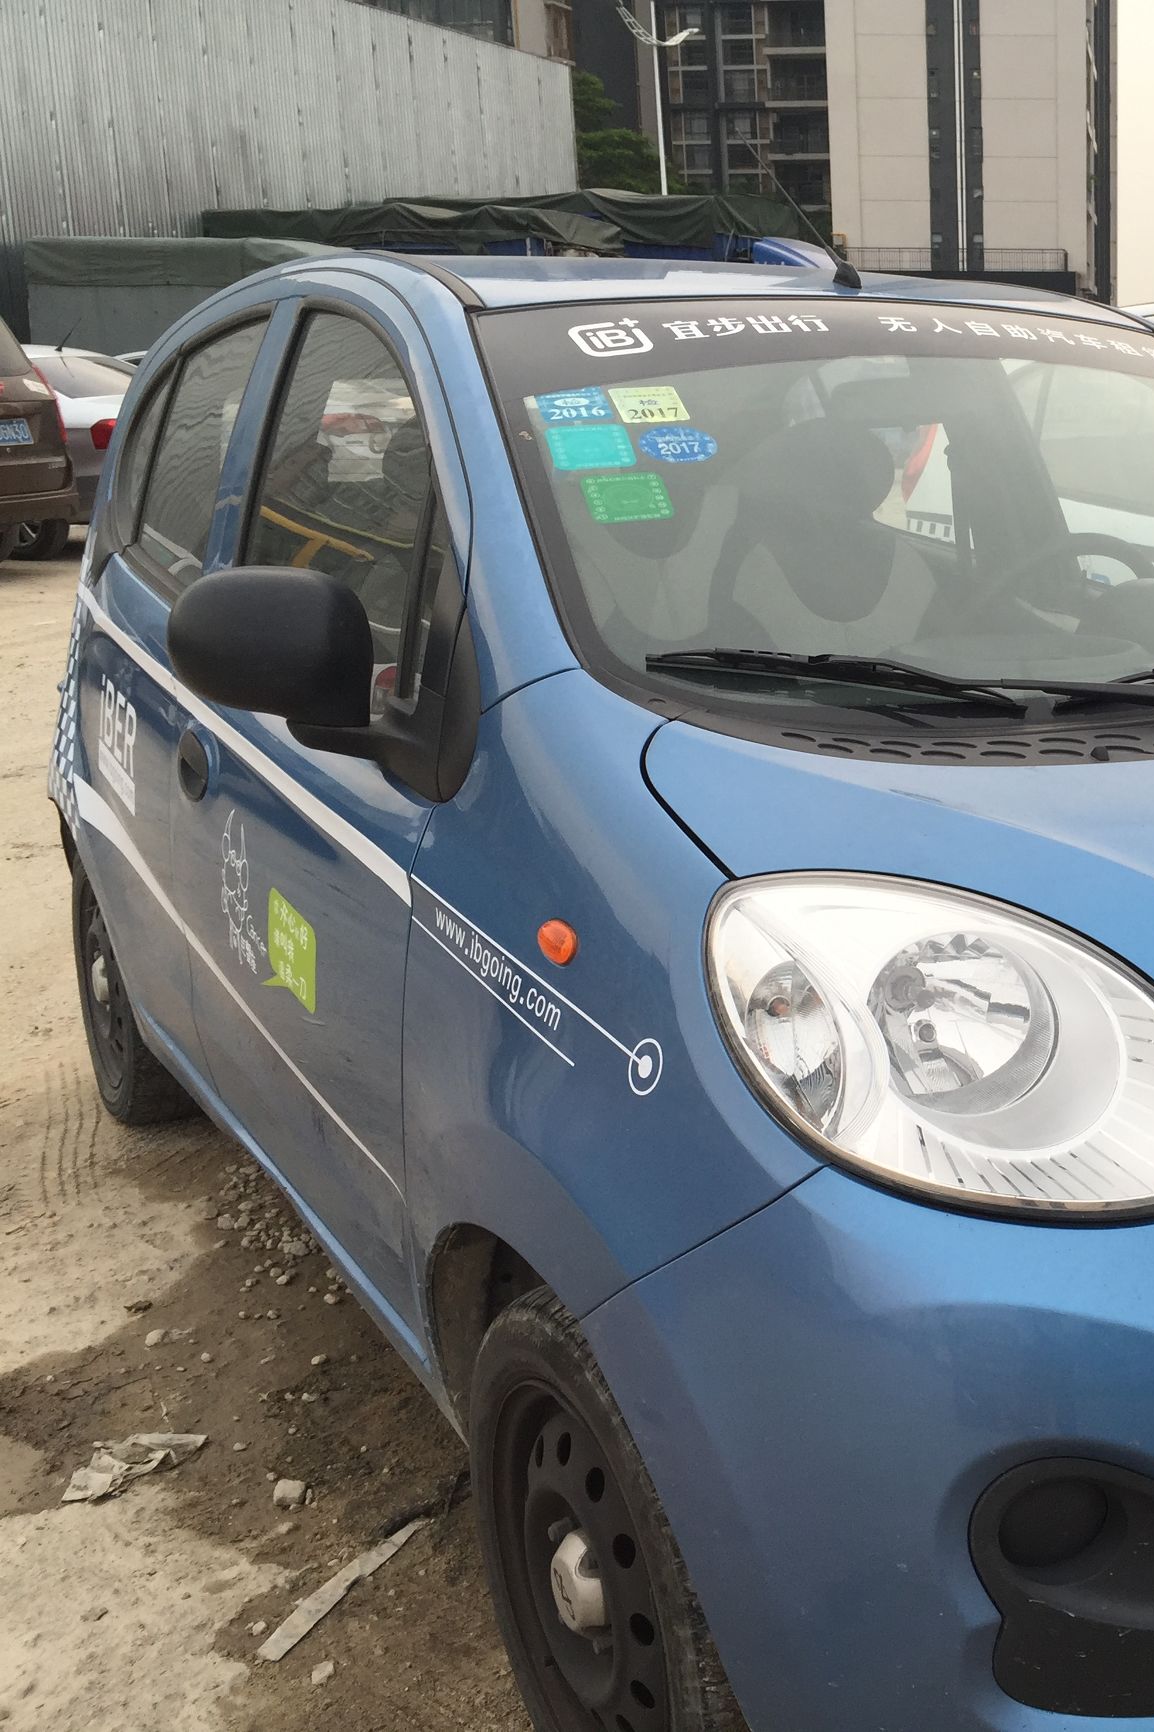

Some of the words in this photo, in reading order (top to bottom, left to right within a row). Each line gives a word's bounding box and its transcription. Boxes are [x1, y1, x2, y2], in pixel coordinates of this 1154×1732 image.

[661, 314, 830, 341] 宜步出行
[550, 406, 606, 421] 2016
[628, 407, 679, 421] 2017
[658, 442, 699, 456] 2017
[100, 673, 137, 778] iBER
[435, 907, 562, 1031] www.ibgoing.com
